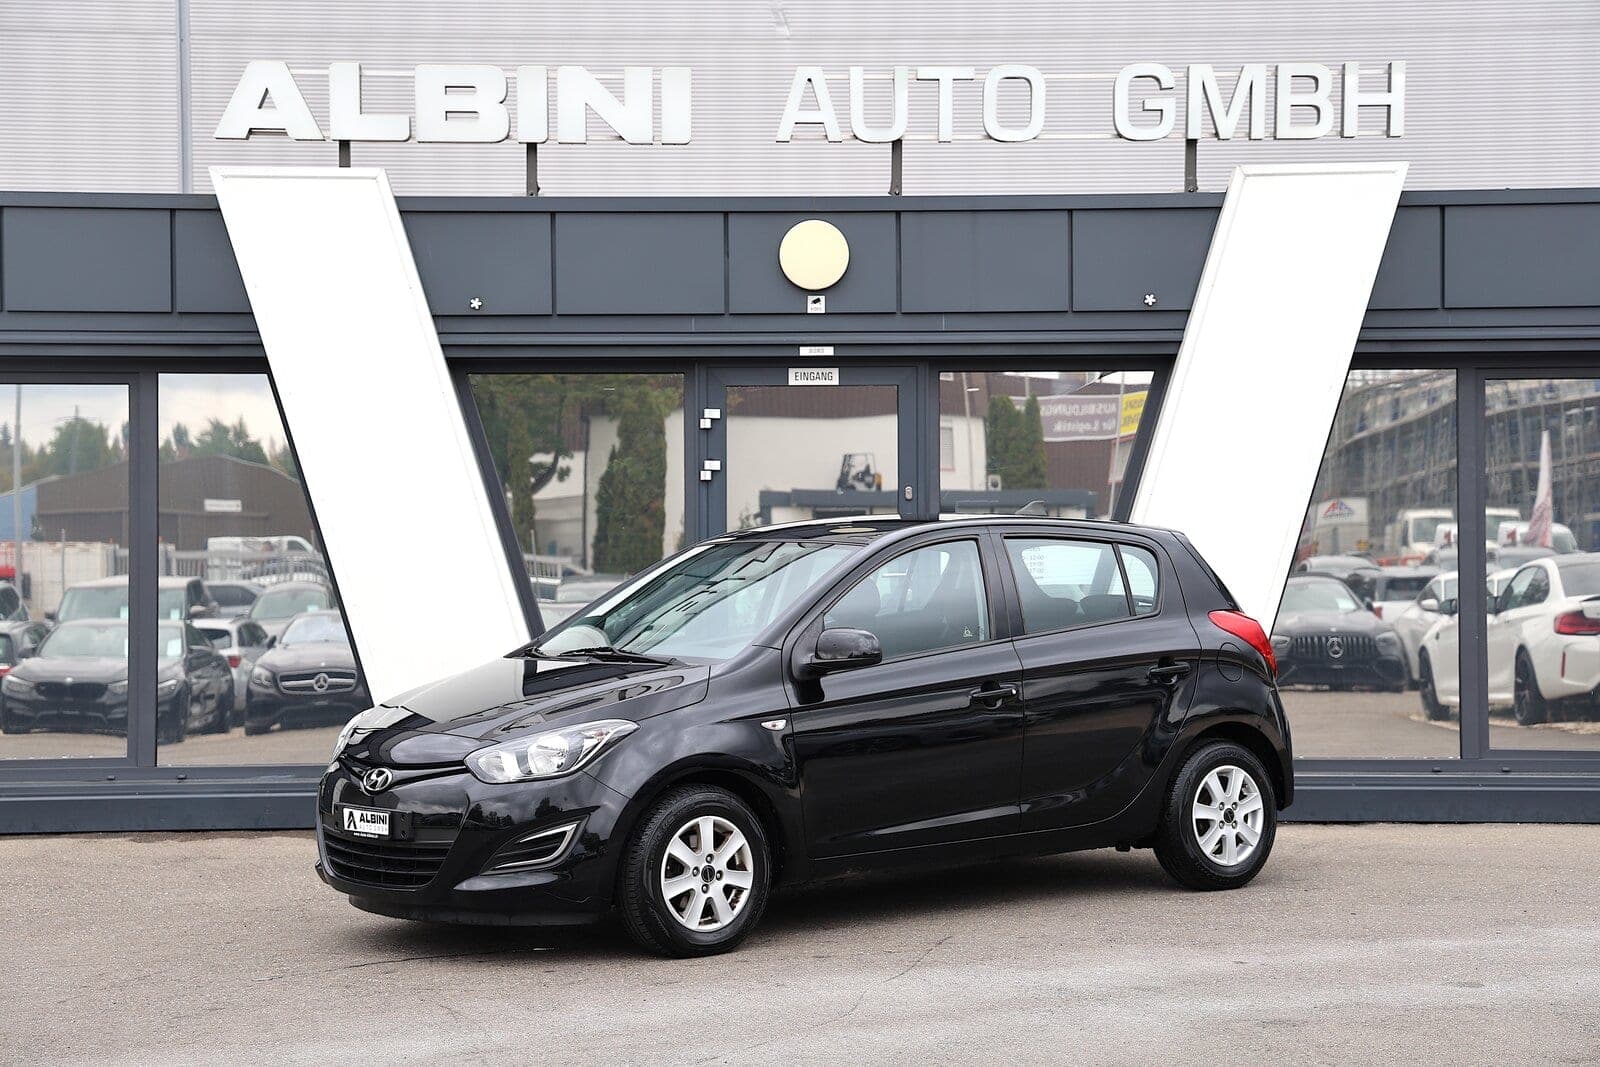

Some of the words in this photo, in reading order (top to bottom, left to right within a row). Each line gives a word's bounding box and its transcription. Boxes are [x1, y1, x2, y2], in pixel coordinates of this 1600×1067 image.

[214, 60, 692, 145] ALBINI
[776, 64, 1046, 143] AUTO
[1113, 60, 1406, 142] GMBH
[794, 371, 833, 381] EINGANG
[359, 812, 387, 825] ALBINI
